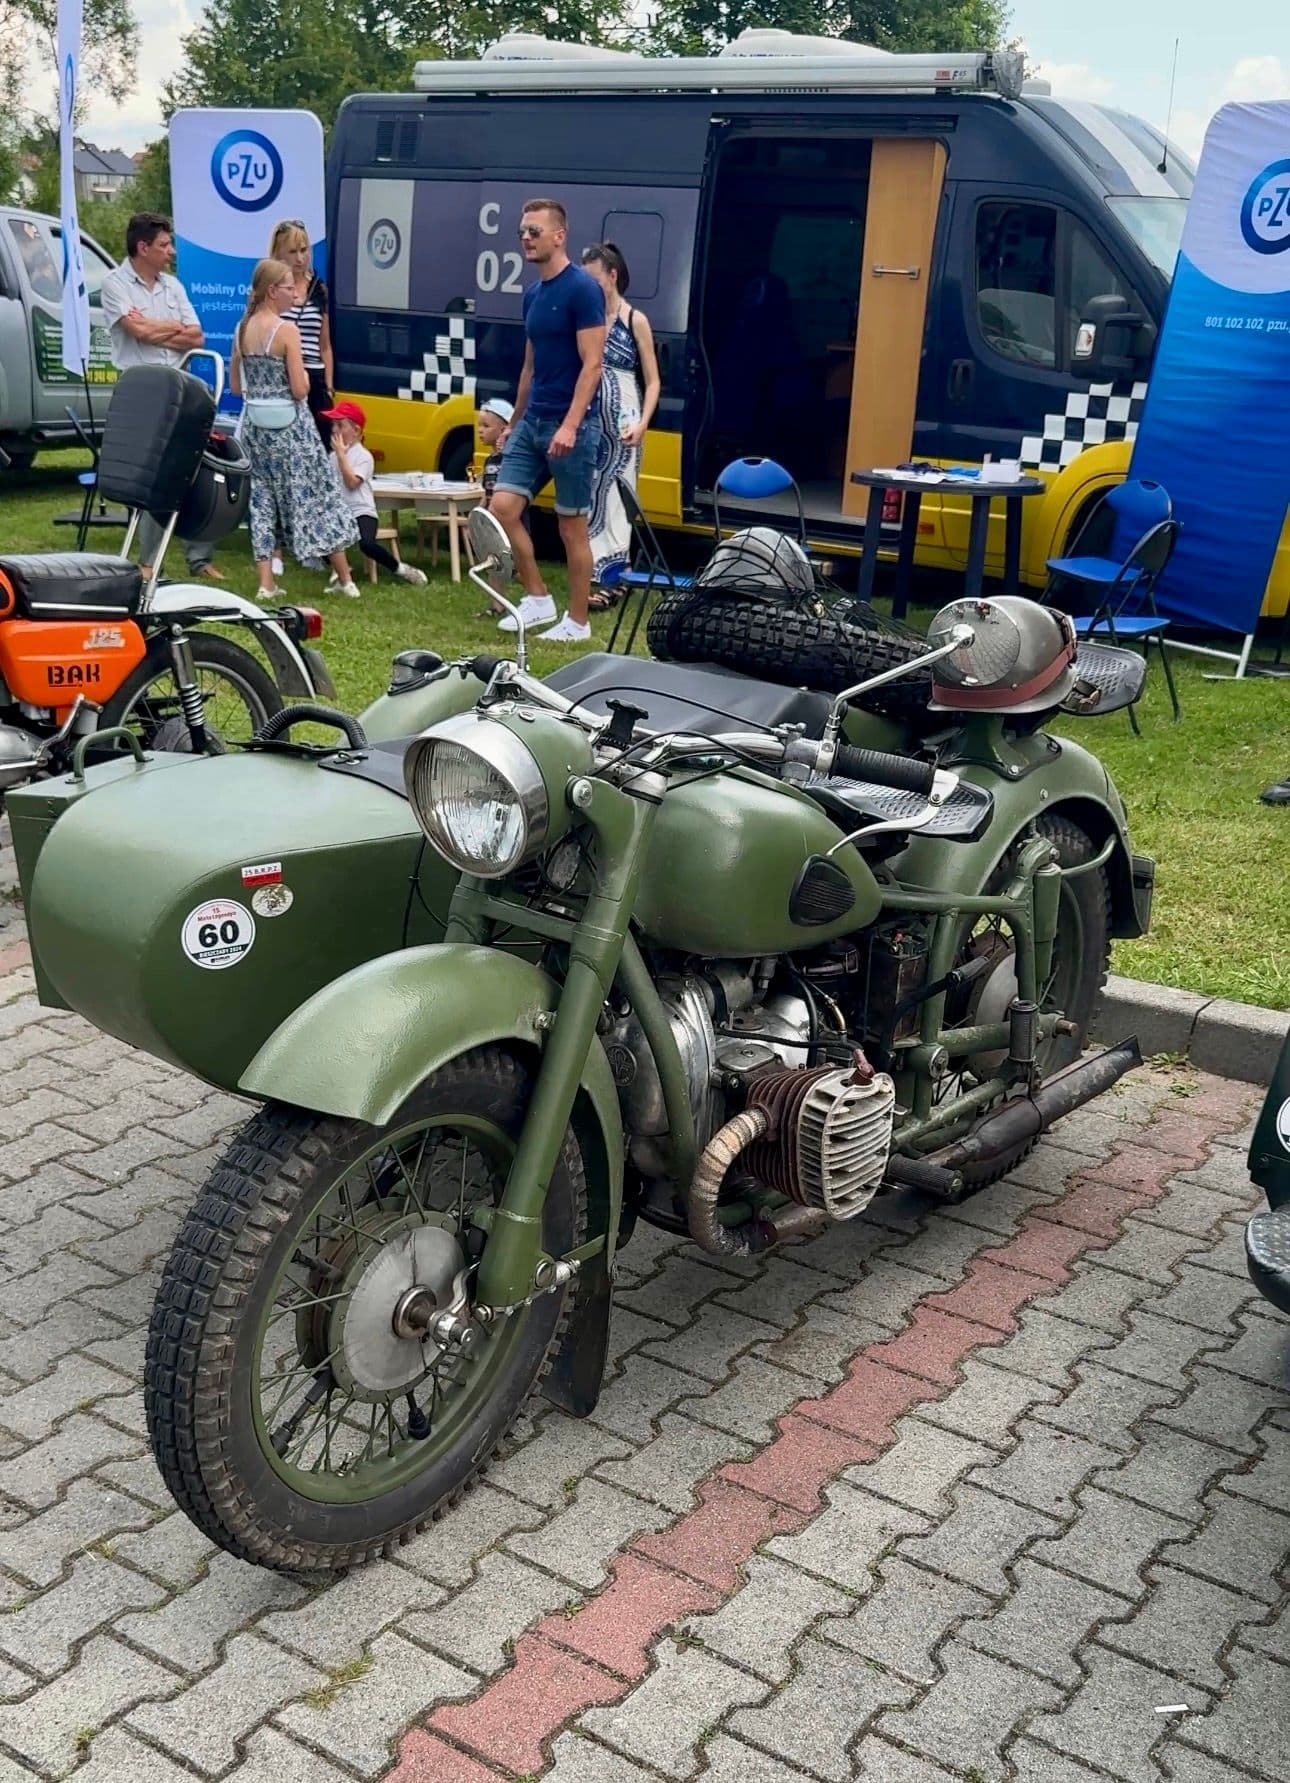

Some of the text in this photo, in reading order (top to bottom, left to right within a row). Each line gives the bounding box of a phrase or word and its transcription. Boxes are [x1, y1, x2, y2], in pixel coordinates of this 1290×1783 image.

[227, 154, 267, 188] PZU
[479, 203, 500, 235] C
[374, 234, 394, 255] PZU
[476, 250, 523, 294] 02
[191, 282, 236, 297] Mobilny
[1205, 316, 1224, 328] 801
[1224, 317, 1244, 329] 102
[1245, 318, 1264, 330] 102
[198, 920, 239, 948] 60
